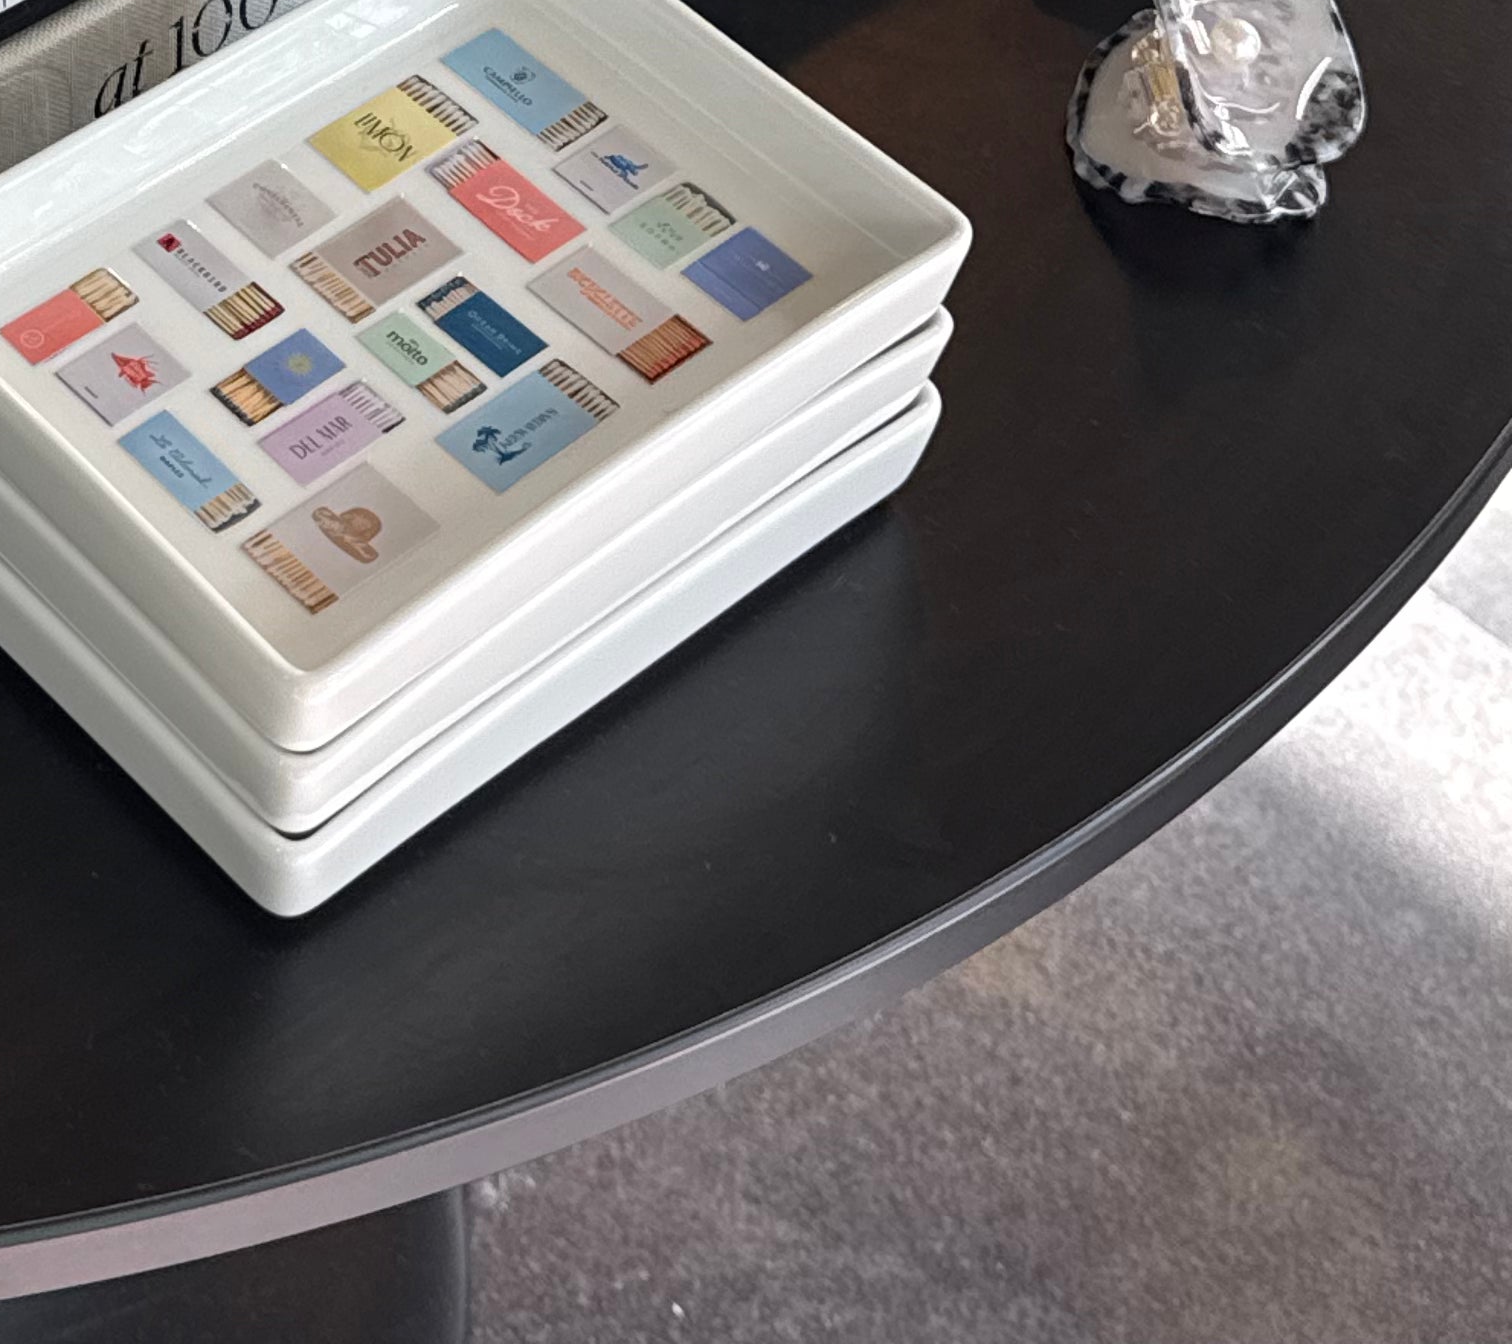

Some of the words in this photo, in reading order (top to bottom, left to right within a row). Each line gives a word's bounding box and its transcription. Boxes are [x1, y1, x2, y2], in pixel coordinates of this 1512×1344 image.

[94, 39, 154, 120] at
[176, 247, 228, 293] BLACKBIRD
[352, 227, 427, 280] TULIA
[288, 433, 324, 461] DEL
[321, 415, 354, 446] MAR
